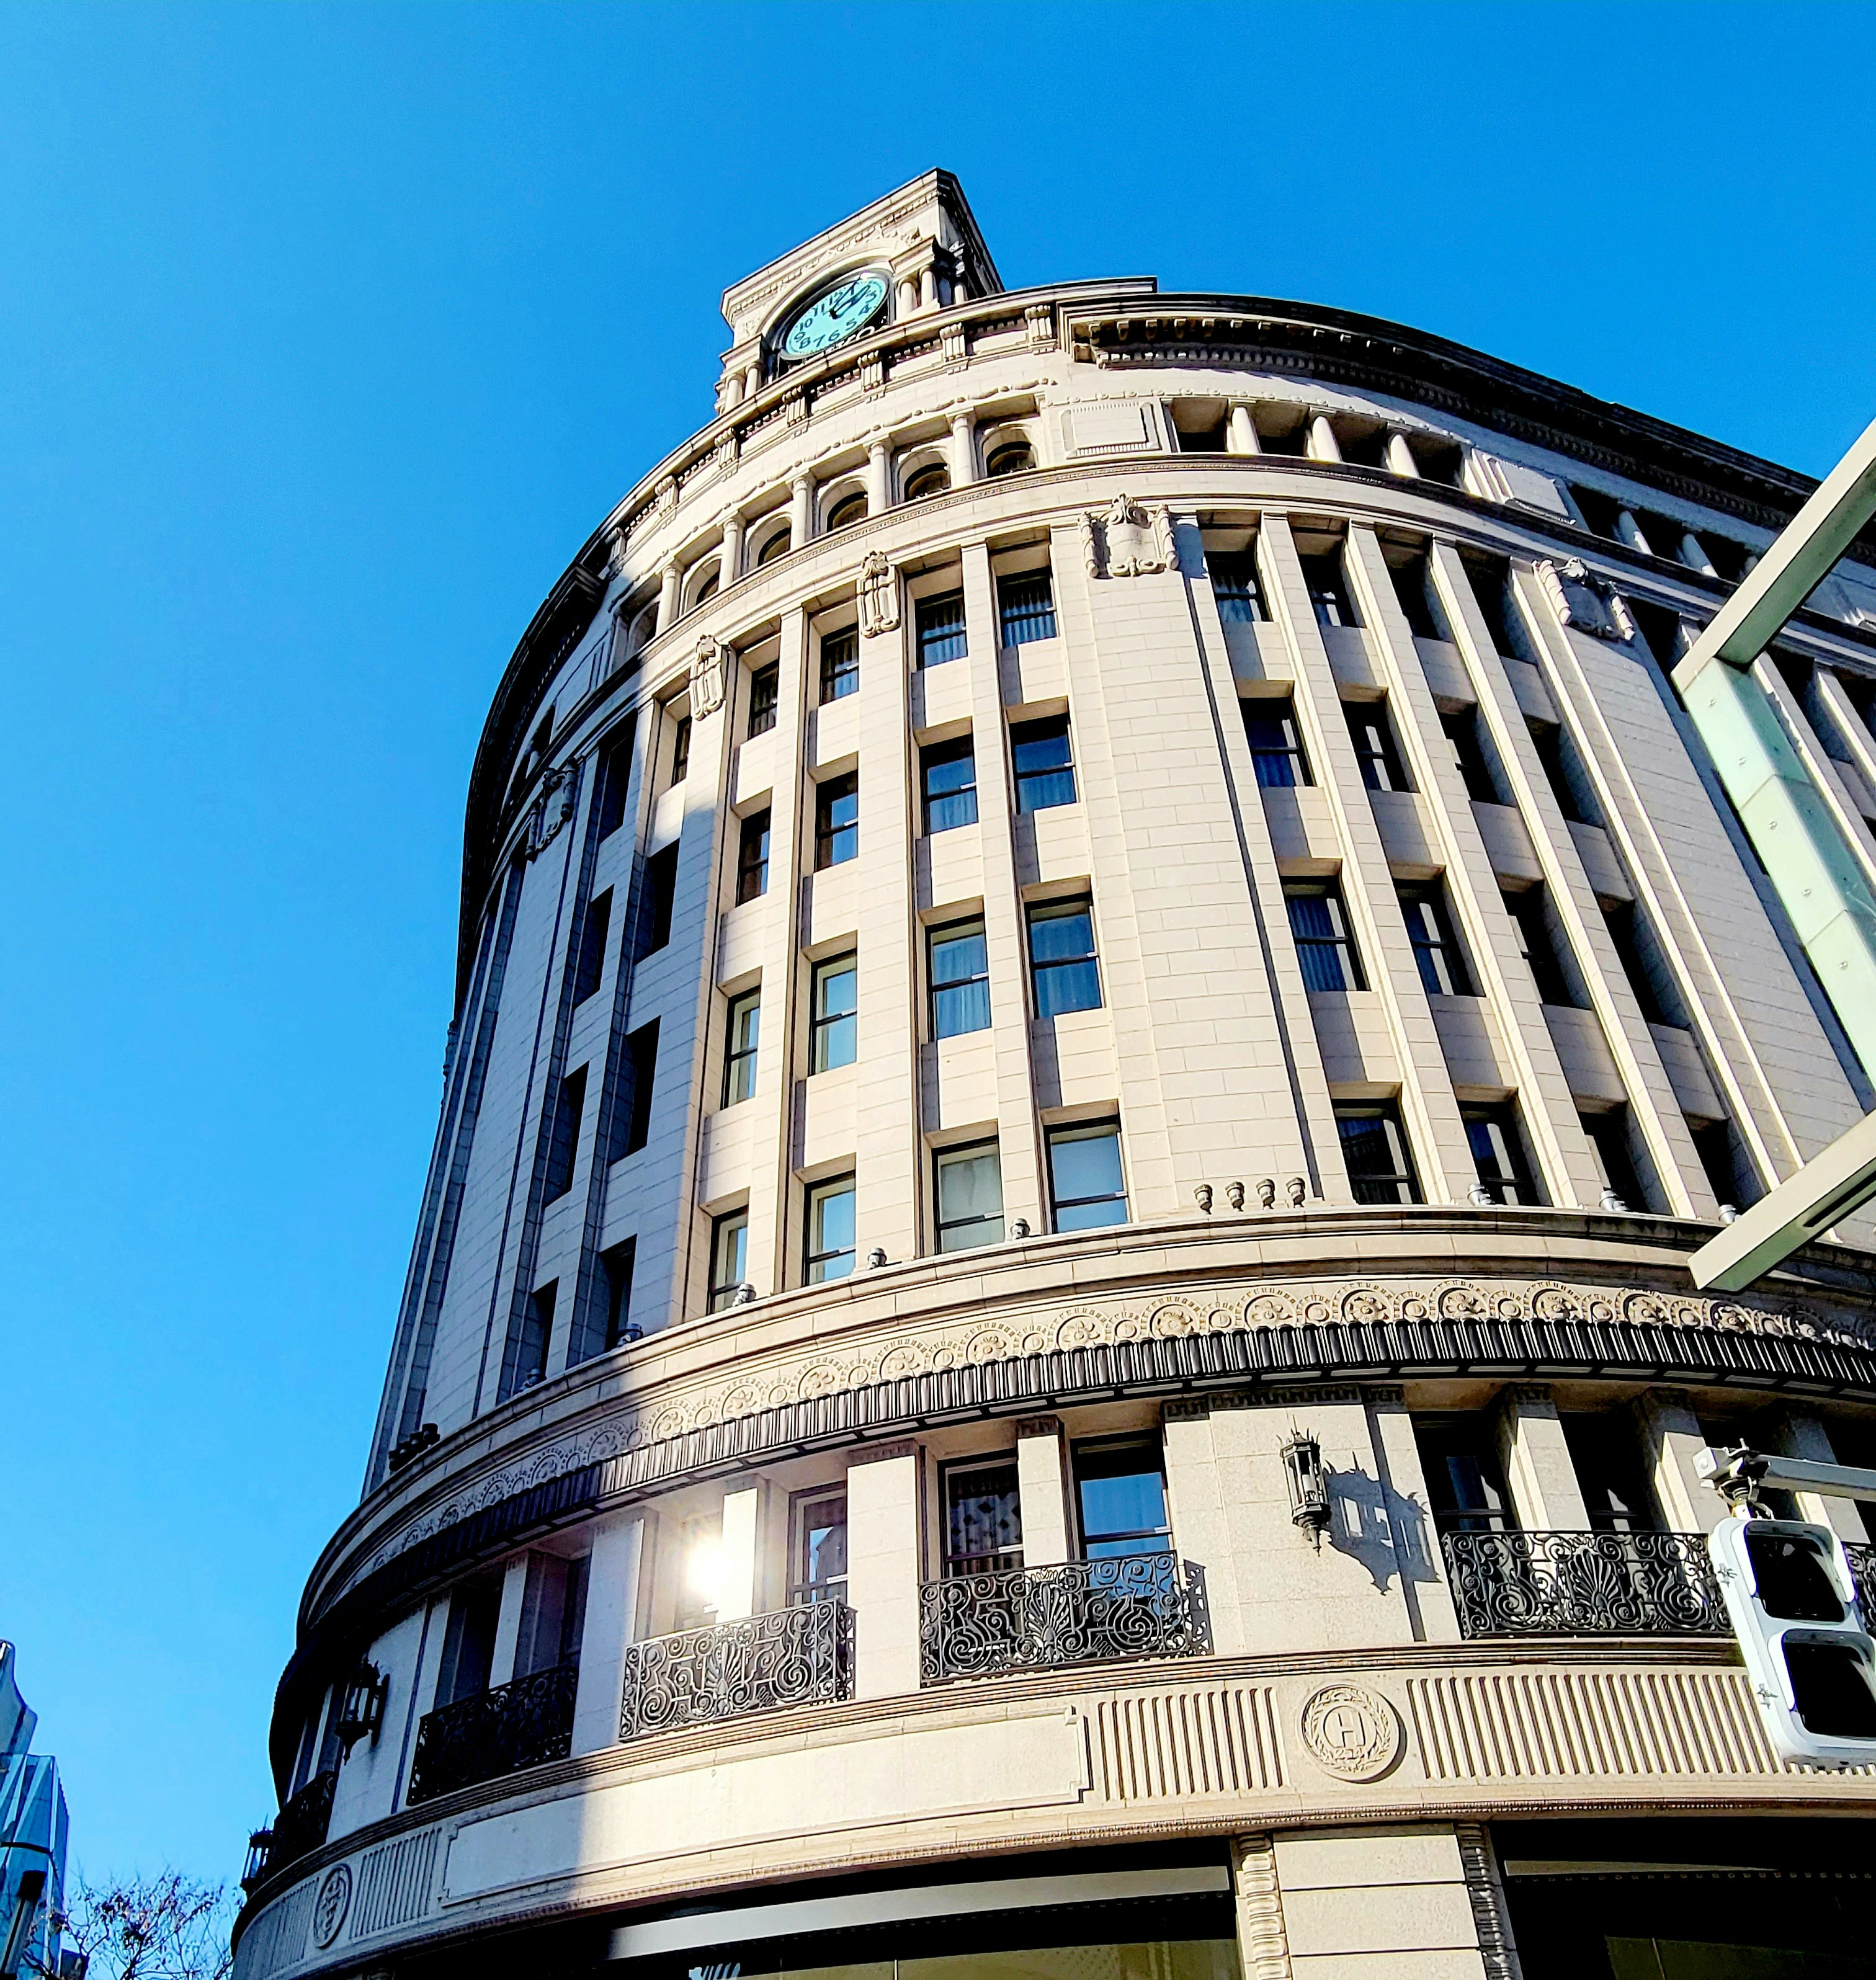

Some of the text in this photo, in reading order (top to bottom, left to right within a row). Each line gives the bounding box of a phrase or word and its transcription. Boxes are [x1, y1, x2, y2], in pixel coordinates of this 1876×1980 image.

[865, 290, 877, 303] 3
[858, 304, 870, 316] 4
[800, 318, 813, 331] 10
[846, 318, 857, 331] 5
[793, 331, 805, 342] 9
[813, 334, 826, 347] 7
[828, 330, 840, 342] 6
[799, 337, 811, 349] 8
[1334, 1710, 1365, 1748] H
